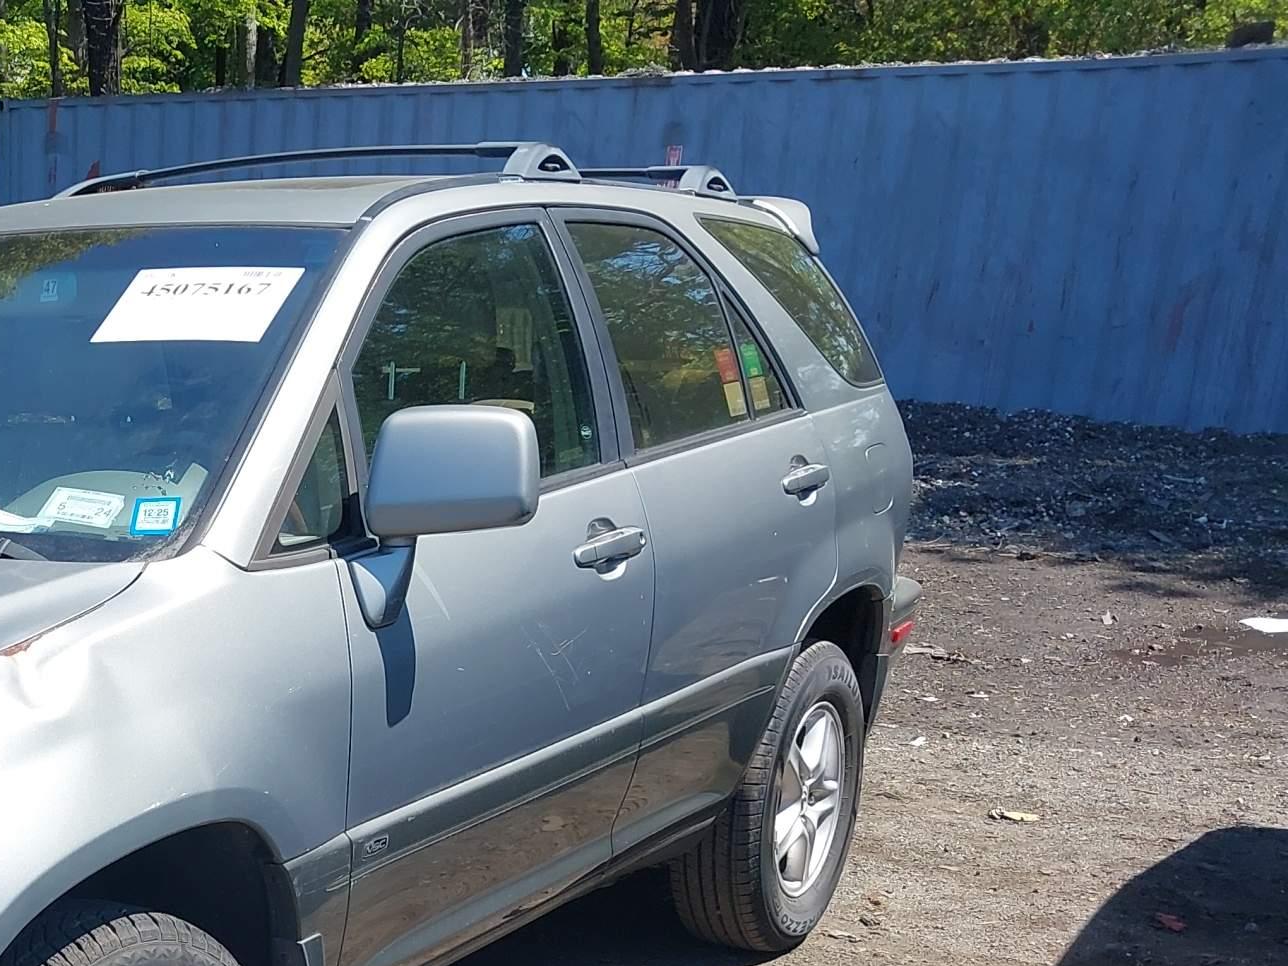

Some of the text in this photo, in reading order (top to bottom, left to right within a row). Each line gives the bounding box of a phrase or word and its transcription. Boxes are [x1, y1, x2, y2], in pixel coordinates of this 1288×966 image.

[44, 280, 57, 295] 47
[140, 282, 272, 298] 45075167
[94, 507, 113, 518] 24
